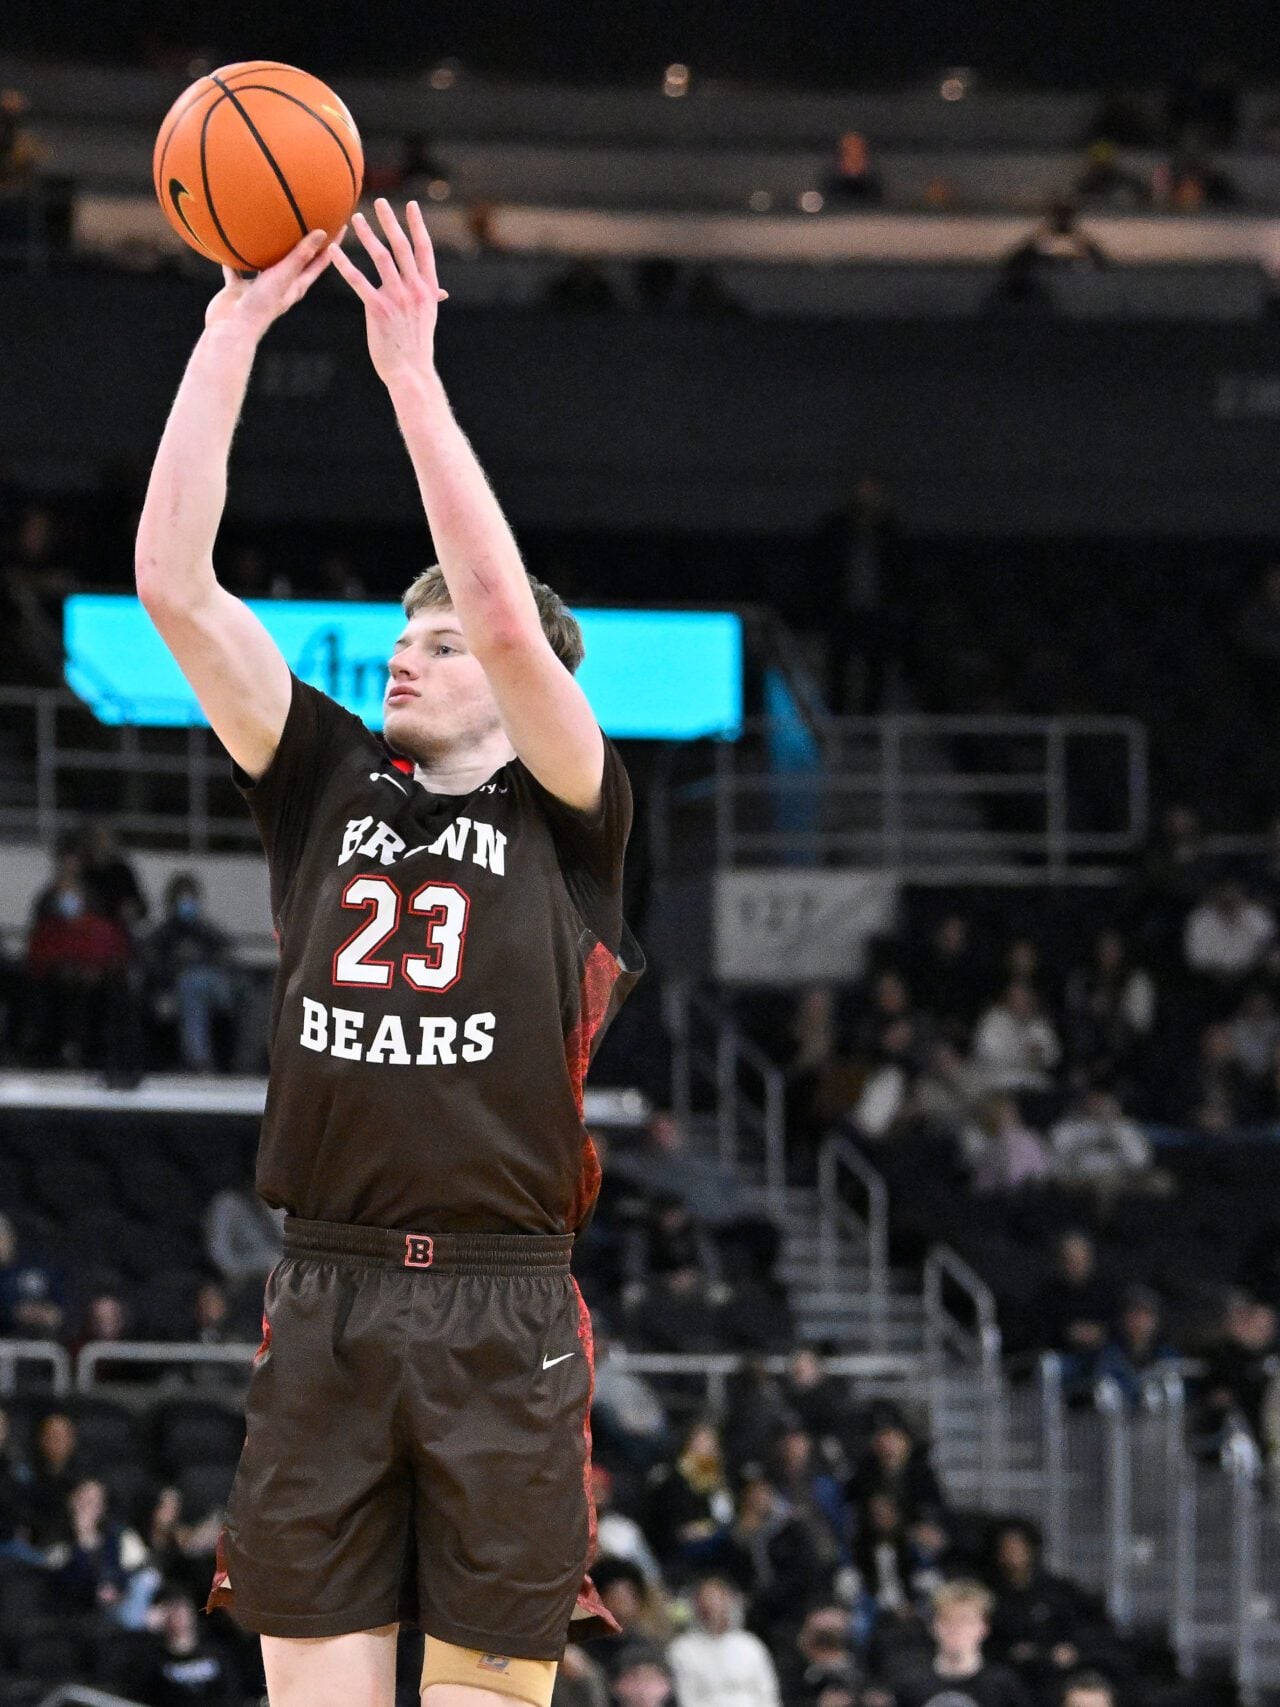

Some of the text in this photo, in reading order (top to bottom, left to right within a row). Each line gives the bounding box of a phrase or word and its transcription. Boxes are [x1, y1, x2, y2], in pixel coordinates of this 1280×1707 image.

[337, 815, 507, 877] BRWN
[332, 874, 470, 994] 23
[300, 996, 497, 1066] BEARS
[404, 1234, 434, 1268] B
